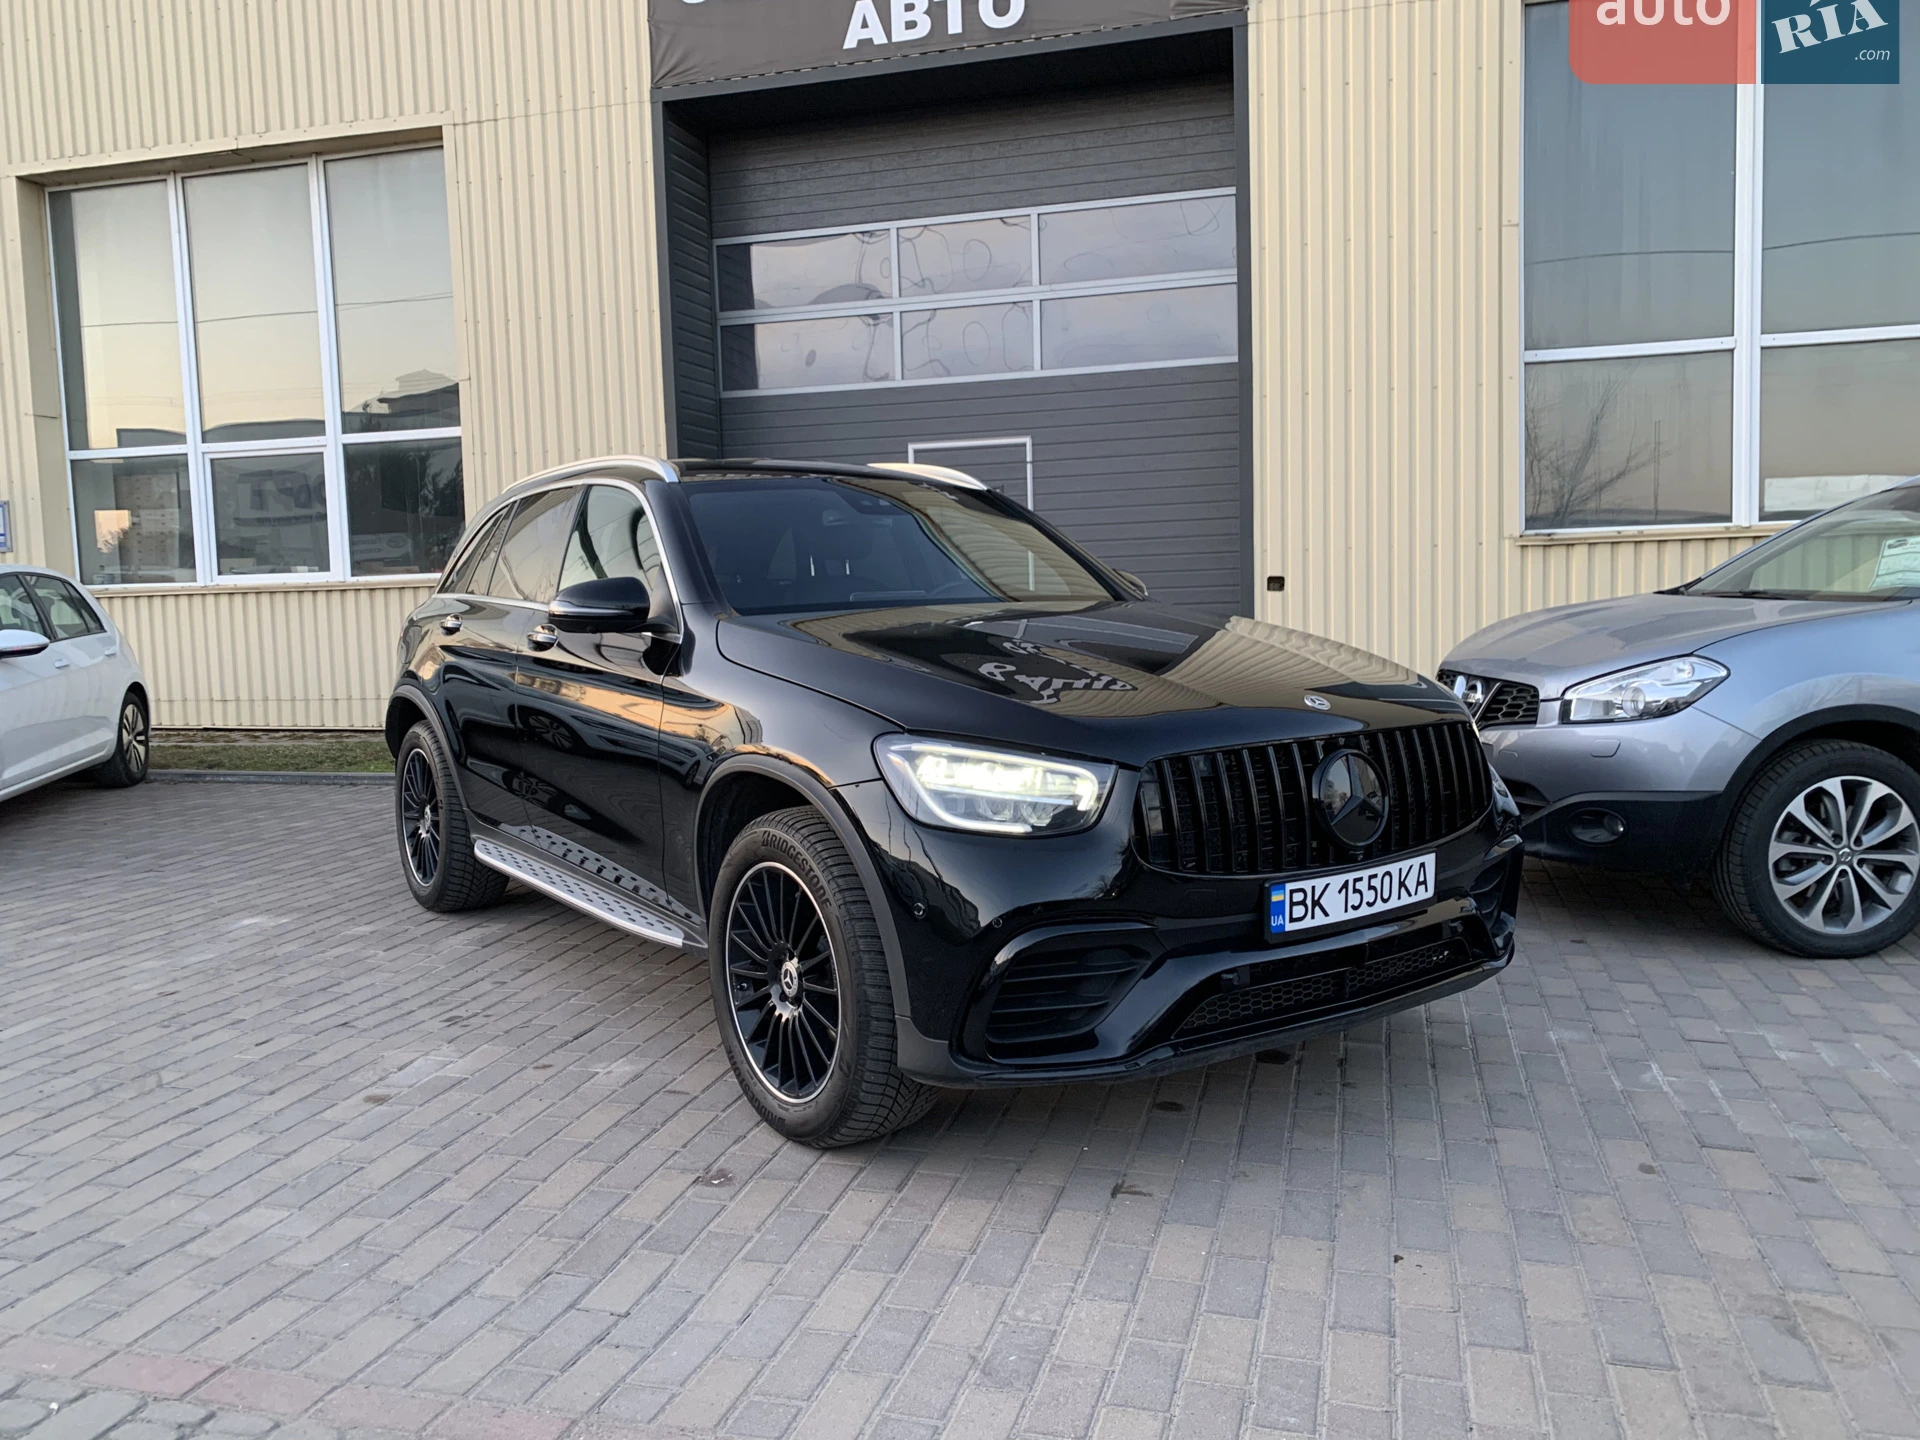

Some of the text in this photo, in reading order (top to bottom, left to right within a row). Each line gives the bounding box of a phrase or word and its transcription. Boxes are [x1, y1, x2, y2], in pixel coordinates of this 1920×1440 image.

[842, 0, 1026, 50] АВТО
[761, 830, 832, 910] BRIDGESTONE
[1288, 861, 1429, 924] BK 1550 KA
[1271, 915, 1285, 927] UA
